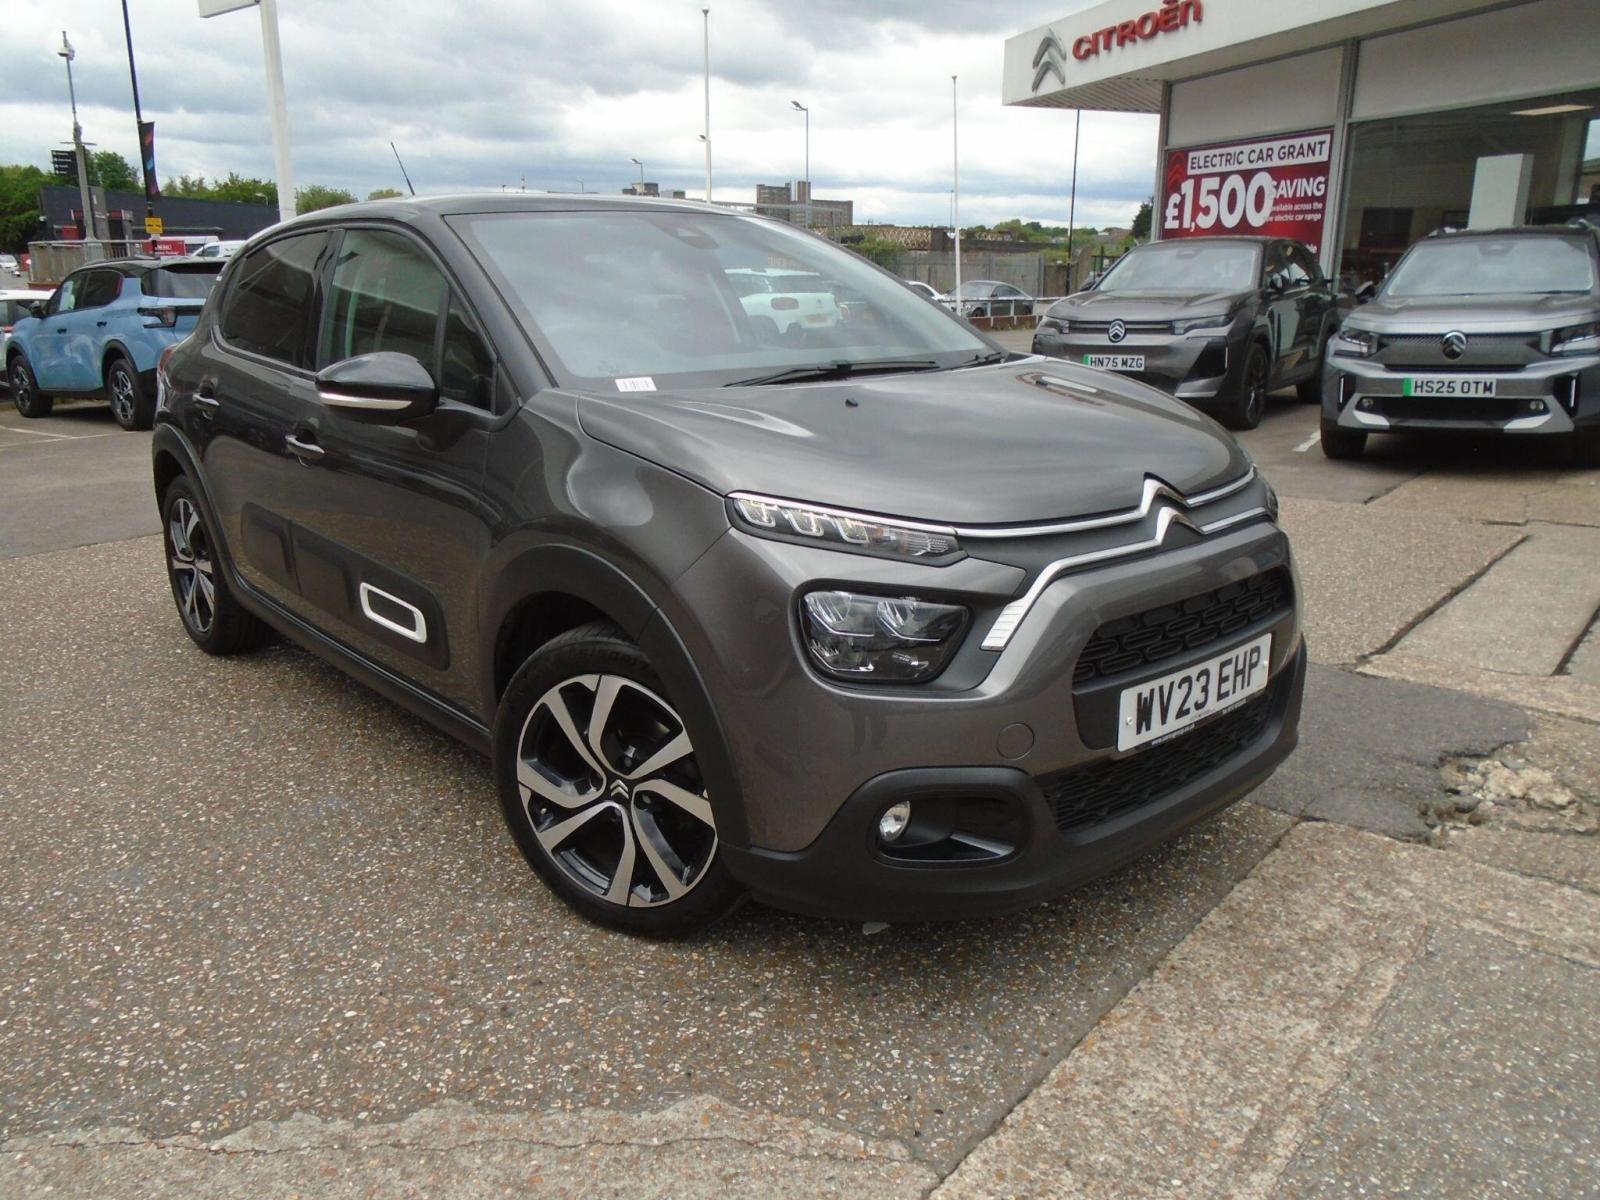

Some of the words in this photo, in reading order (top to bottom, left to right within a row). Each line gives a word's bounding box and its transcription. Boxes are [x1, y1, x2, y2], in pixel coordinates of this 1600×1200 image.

[1190, 150, 1244, 170] ELECTRIC
[1248, 148, 1273, 164] CAR
[1277, 140, 1326, 160] GRANT
[1270, 176, 1325, 199] SAVING
[1165, 171, 1274, 232] £1,500
[1313, 201, 1323, 210] the
[1090, 357, 1118, 368] HN75
[1121, 357, 1143, 369] MZG
[1414, 380, 1456, 394] HS25
[1461, 381, 1493, 394] OTM
[1136, 668, 1210, 736] WV23
[1217, 645, 1261, 702] EHP
